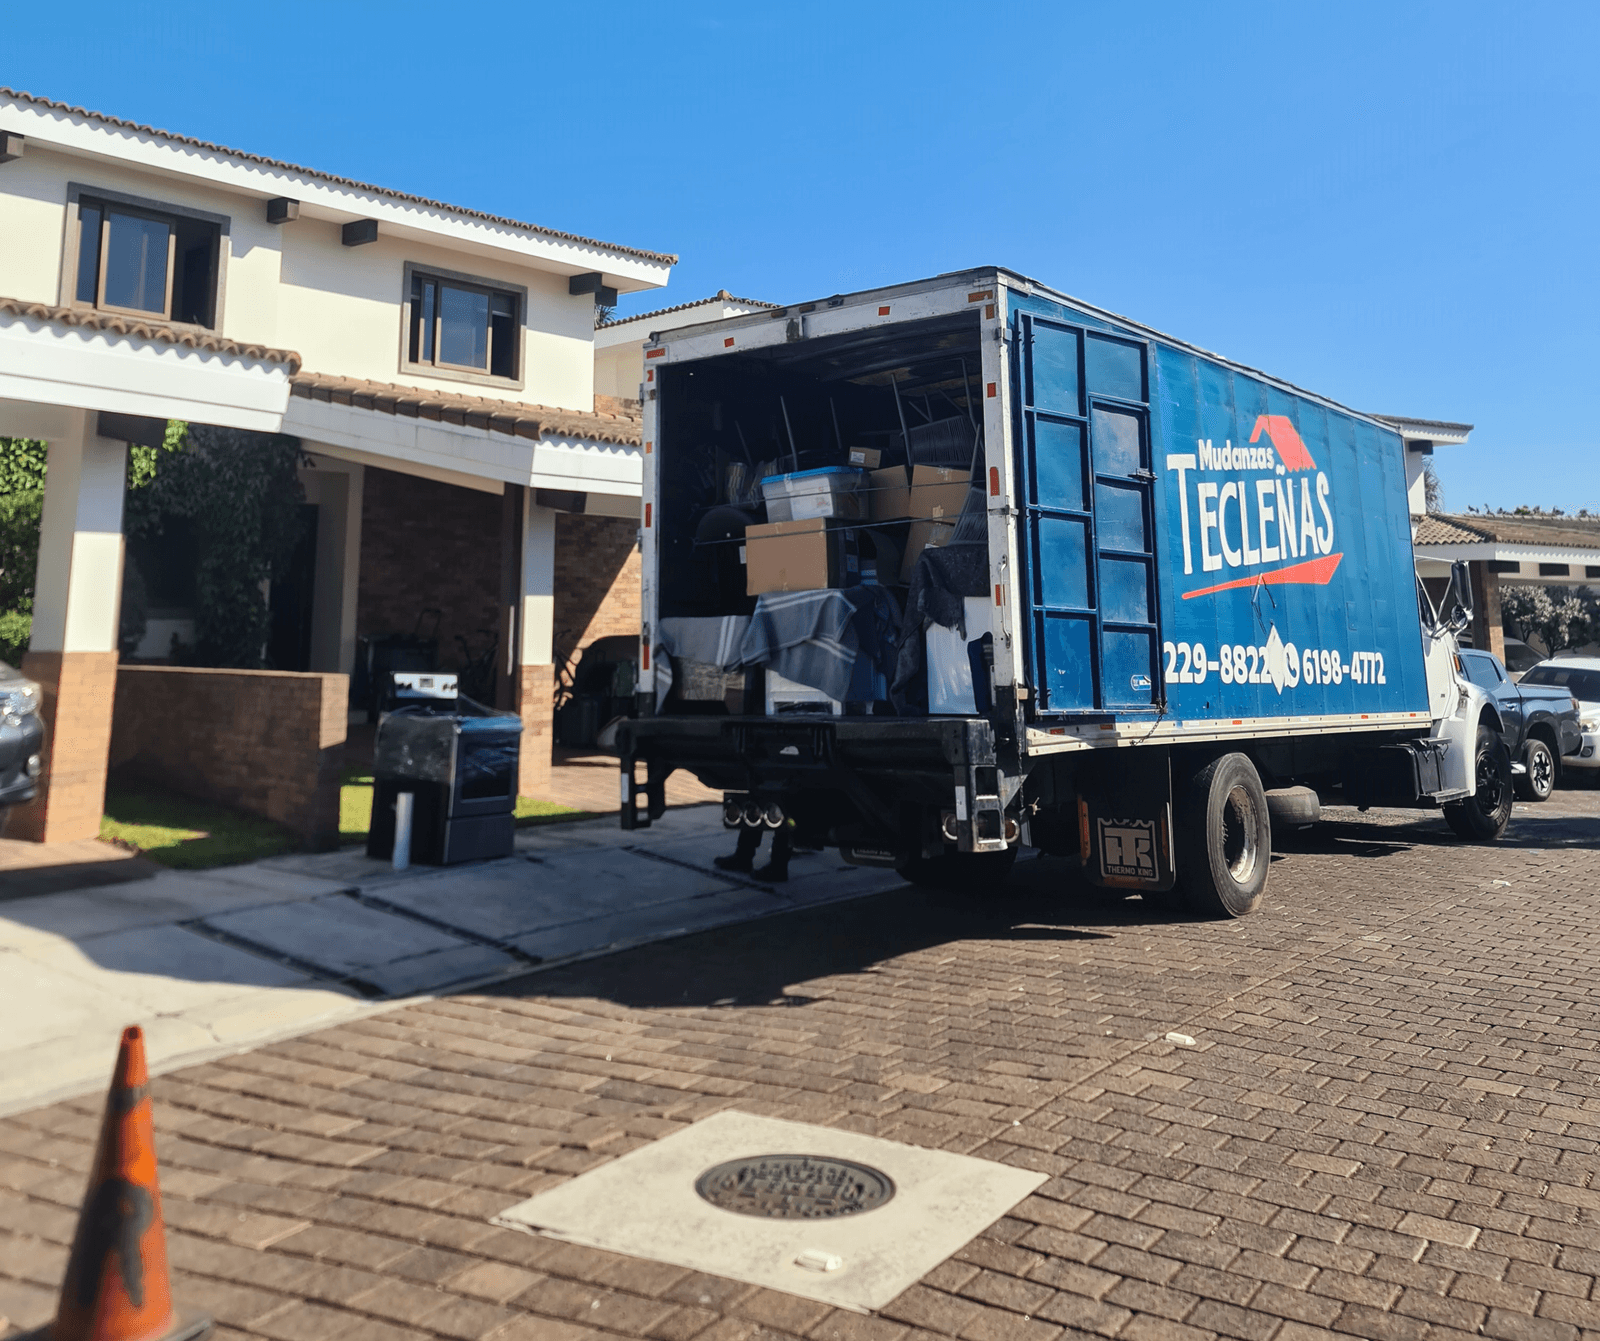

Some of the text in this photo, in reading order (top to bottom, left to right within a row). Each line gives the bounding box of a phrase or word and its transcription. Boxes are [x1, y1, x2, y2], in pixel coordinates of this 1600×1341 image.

[1198, 439, 1275, 472] Mudanzas
[1166, 454, 1335, 575] TECLEÑAS
[1302, 649, 1387, 685] 6198-4772
[1107, 865, 1153, 877] THERMO KING
